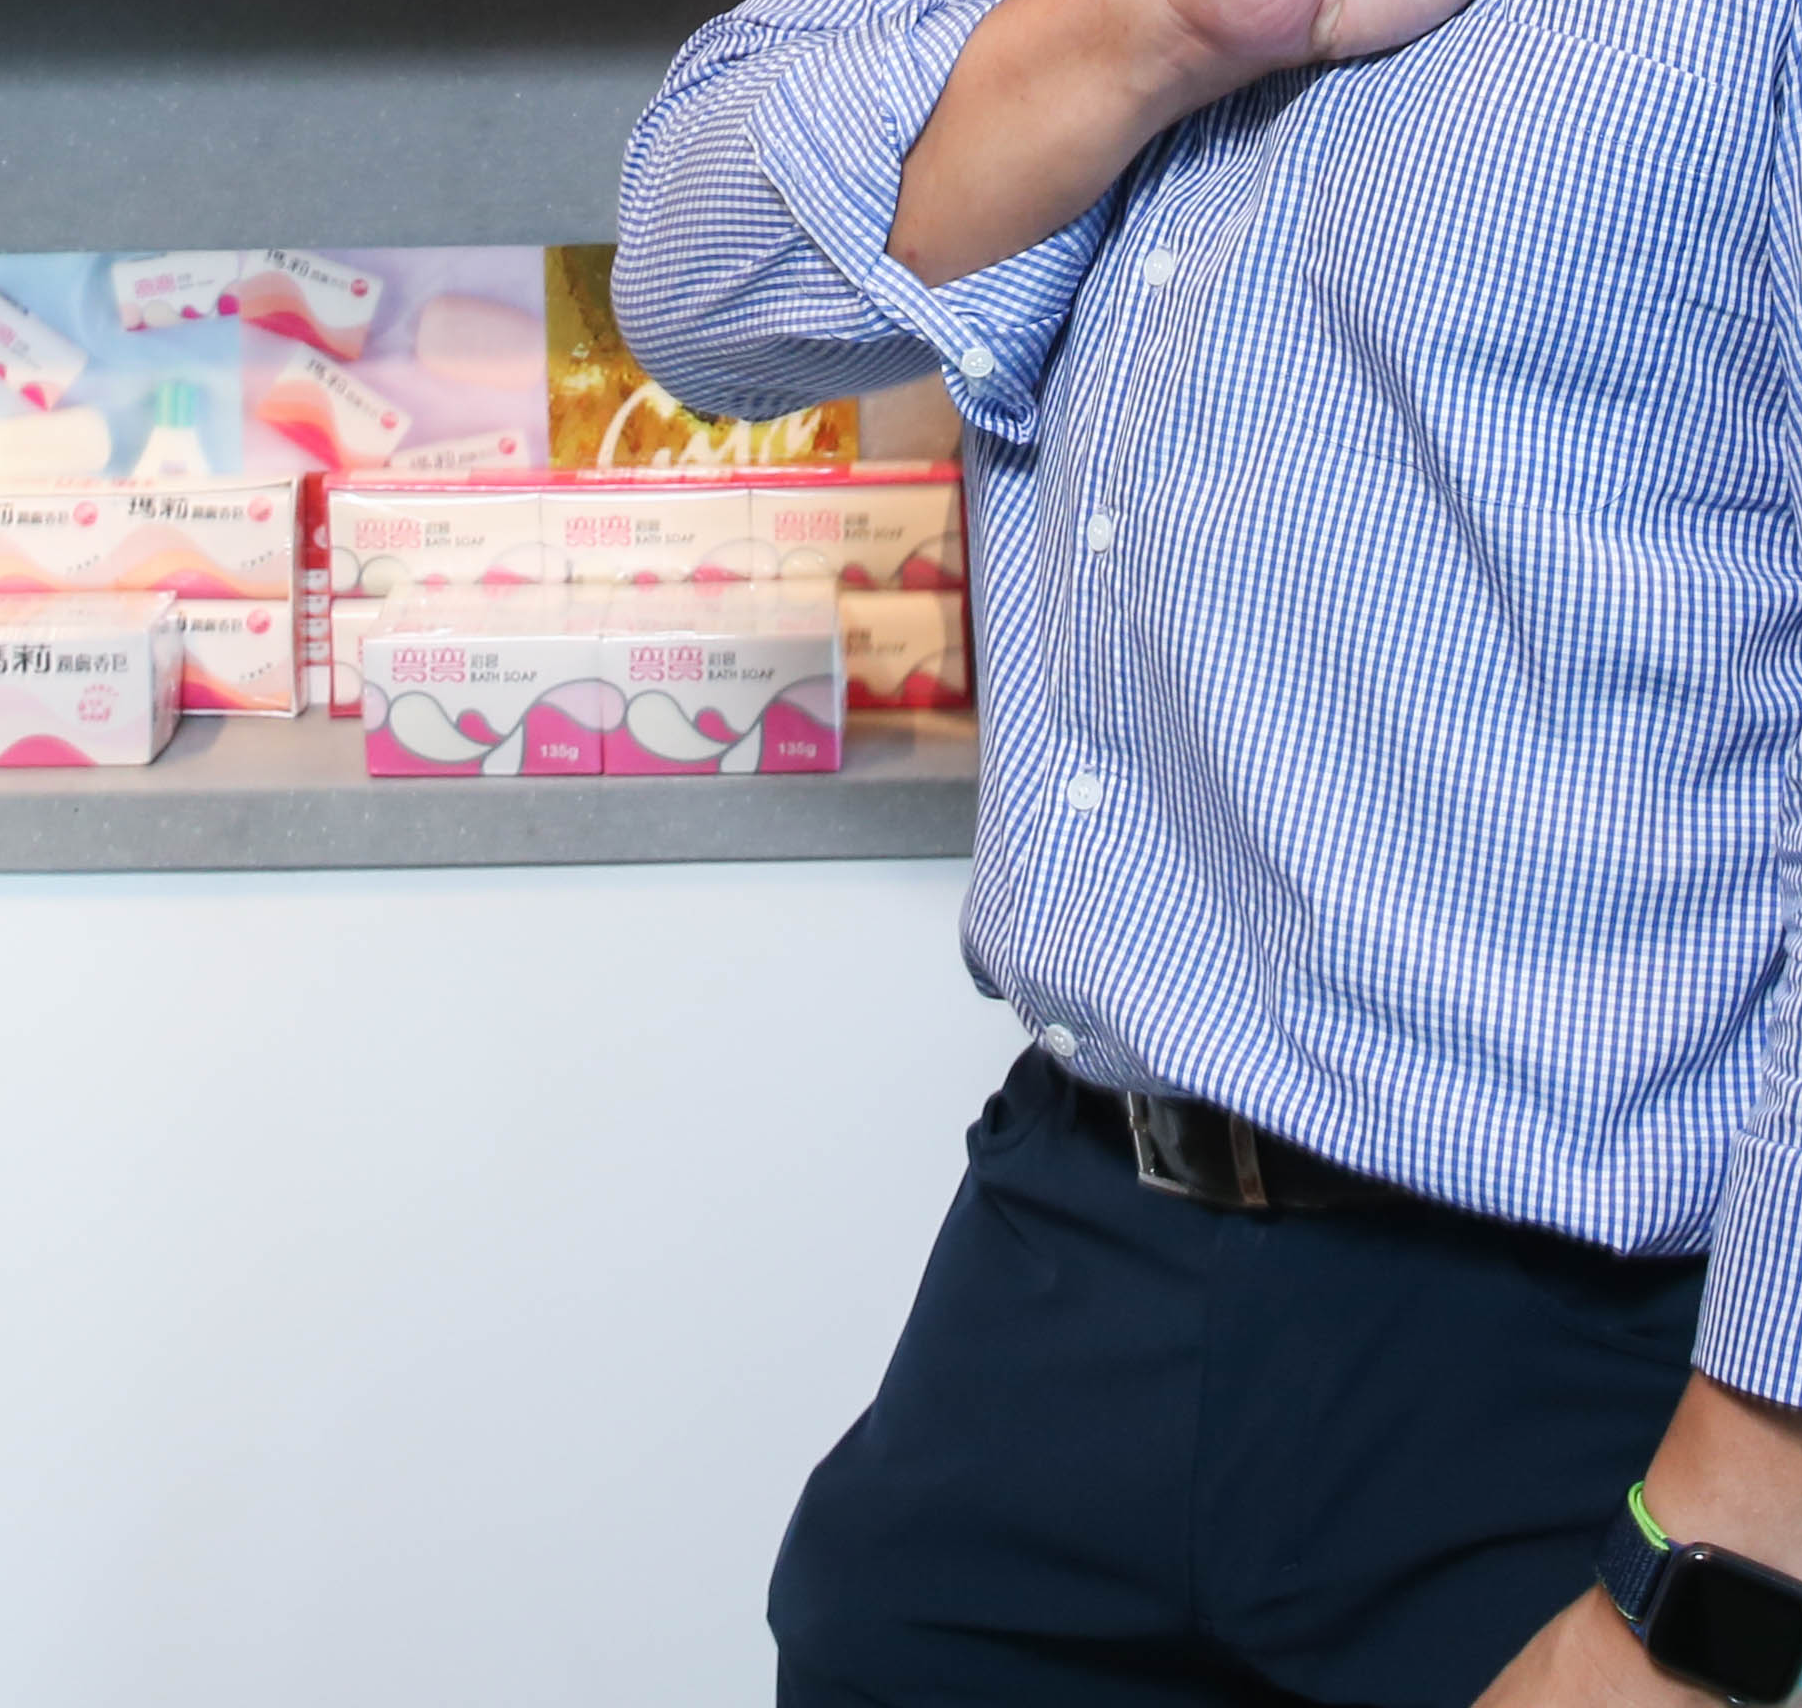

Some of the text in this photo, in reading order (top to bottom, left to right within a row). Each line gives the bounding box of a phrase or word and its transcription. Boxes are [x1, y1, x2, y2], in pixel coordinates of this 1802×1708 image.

[470, 671, 537, 683] BATH SOAP
[708, 668, 776, 681] BATH SOAP
[540, 744, 579, 761] 135g
[778, 742, 817, 758] 135g
